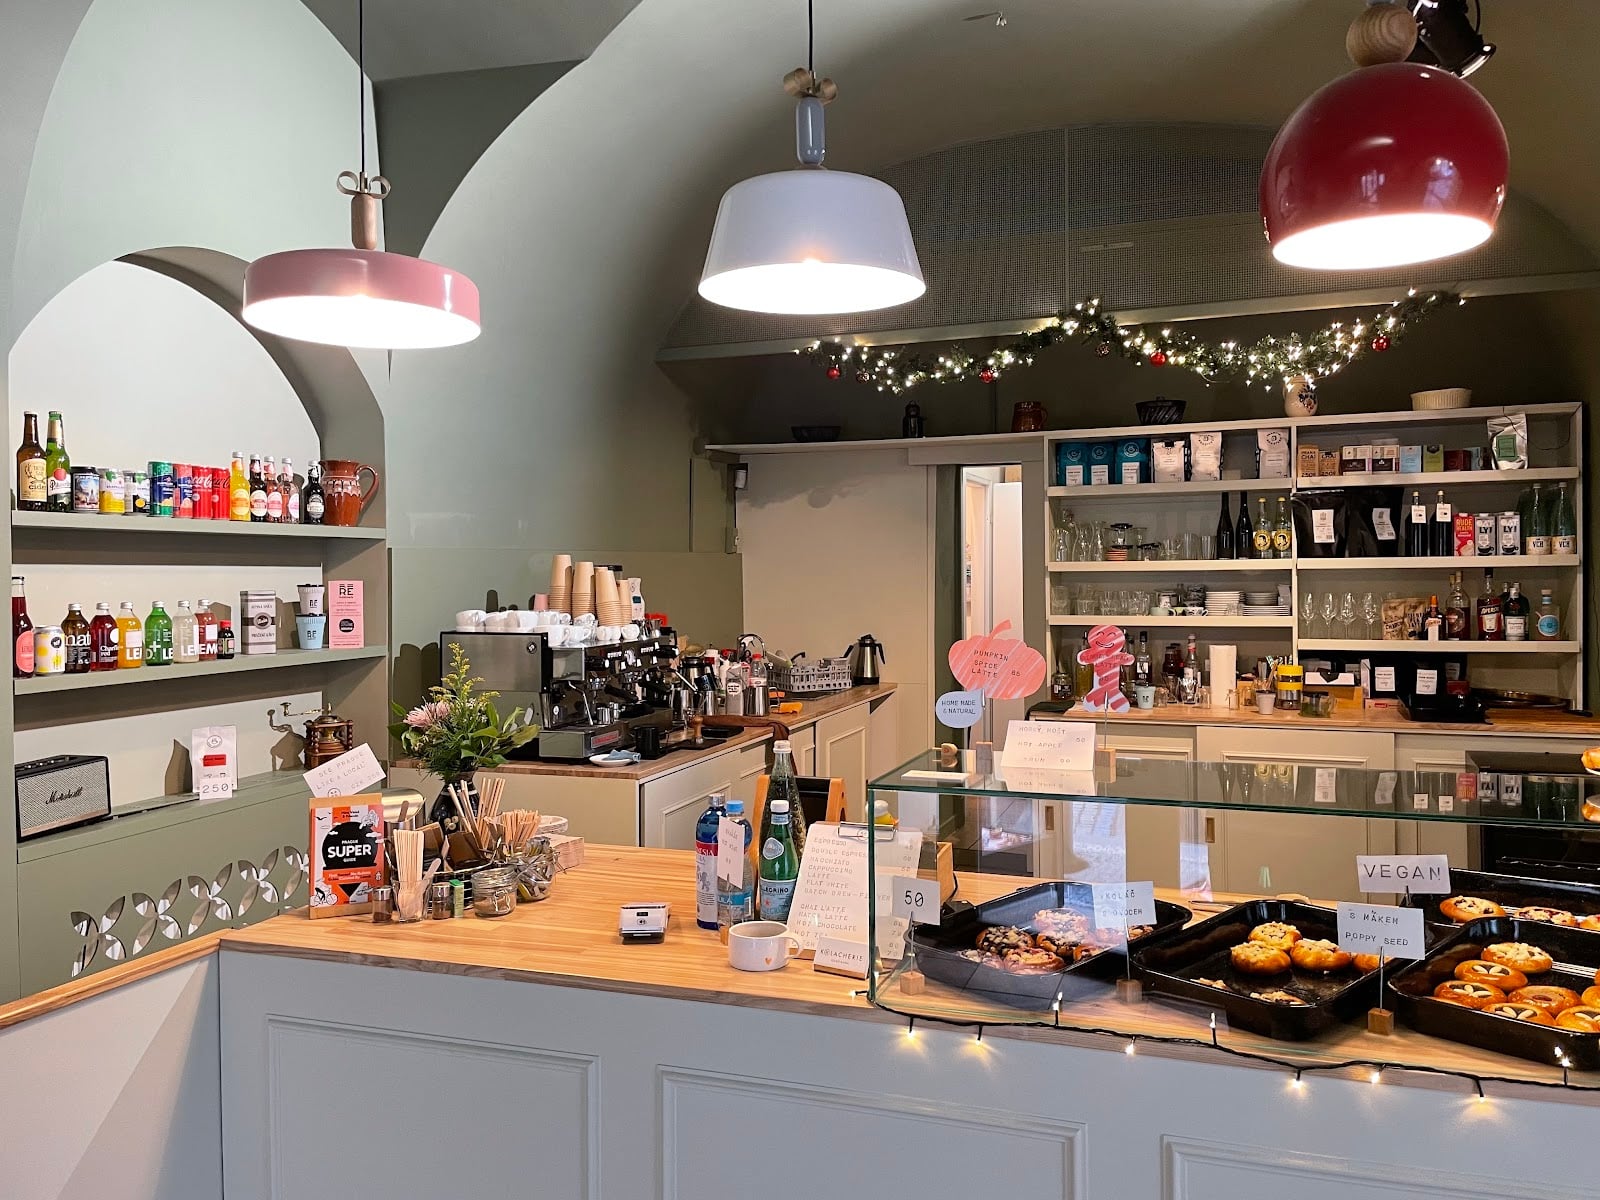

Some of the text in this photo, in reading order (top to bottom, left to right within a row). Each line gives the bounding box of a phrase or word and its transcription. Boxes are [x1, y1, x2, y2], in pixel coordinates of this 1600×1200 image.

[973, 649, 1009, 662] PUMPKIN
[974, 660, 998, 670] SPICE
[971, 668, 998, 678] LATTE
[202, 783, 229, 794] 250
[45, 786, 83, 804] Marshall
[327, 844, 372, 858] SUPER
[808, 864, 853, 874] CAPPUCCINO
[1363, 863, 1441, 881] VEGAN
[806, 879, 824, 887] FLAT
[904, 890, 924, 908] 50
[816, 921, 857, 931] CHOCOLATE
[1345, 931, 1409, 946] POPPY SEED
